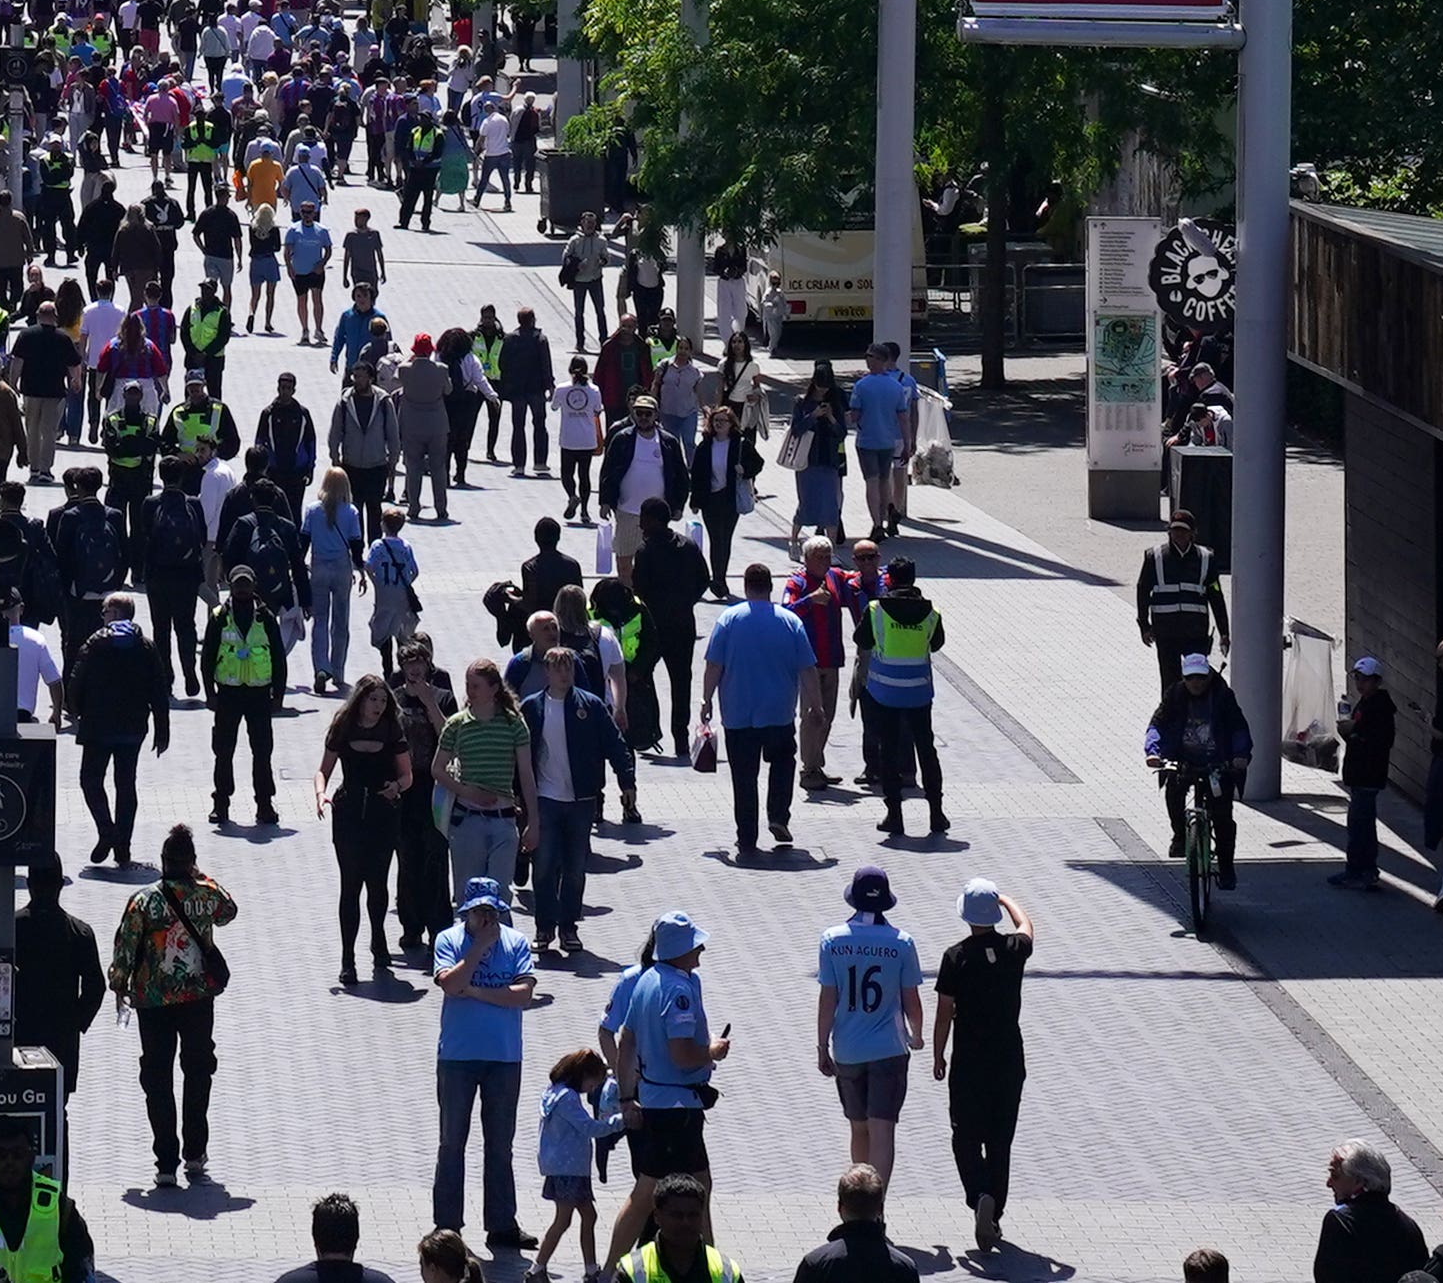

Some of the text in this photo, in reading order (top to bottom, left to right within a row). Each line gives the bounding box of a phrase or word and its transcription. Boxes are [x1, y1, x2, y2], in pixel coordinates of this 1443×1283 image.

[789, 280, 803, 290] ICE
[805, 279, 840, 290] CREAM
[1183, 285, 1236, 322] COFFE
[0, 761, 25, 769] Priority
[831, 945, 898, 959] KUN AGUERO
[471, 970, 512, 980] TIHAD
[847, 965, 882, 1013] 16
[22, 1089, 46, 1104] Go
